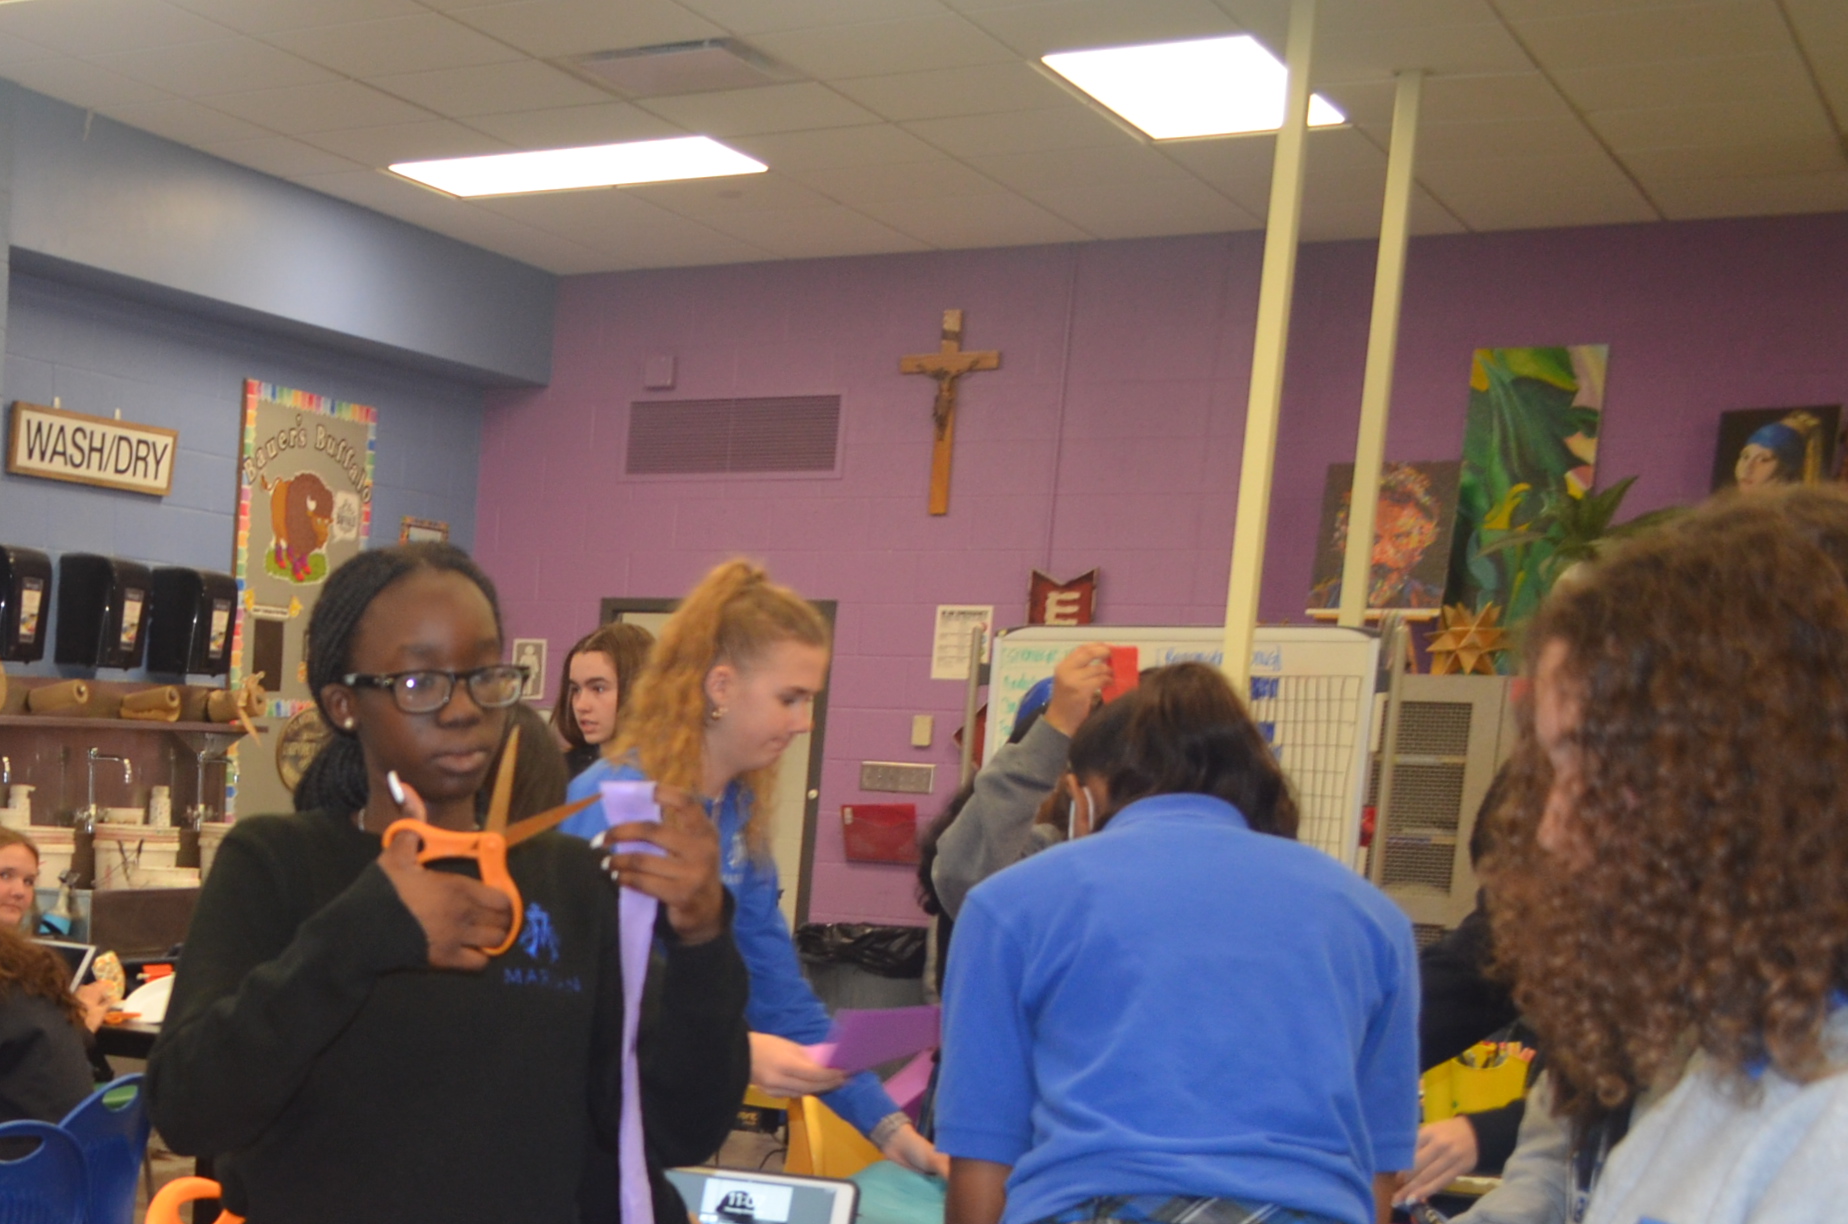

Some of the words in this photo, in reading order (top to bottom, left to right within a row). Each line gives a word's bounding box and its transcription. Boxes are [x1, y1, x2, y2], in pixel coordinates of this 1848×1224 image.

[26, 418, 169, 481] WASH/DRY
[243, 413, 307, 486] Bauer's
[314, 423, 372, 505] Buffalo
